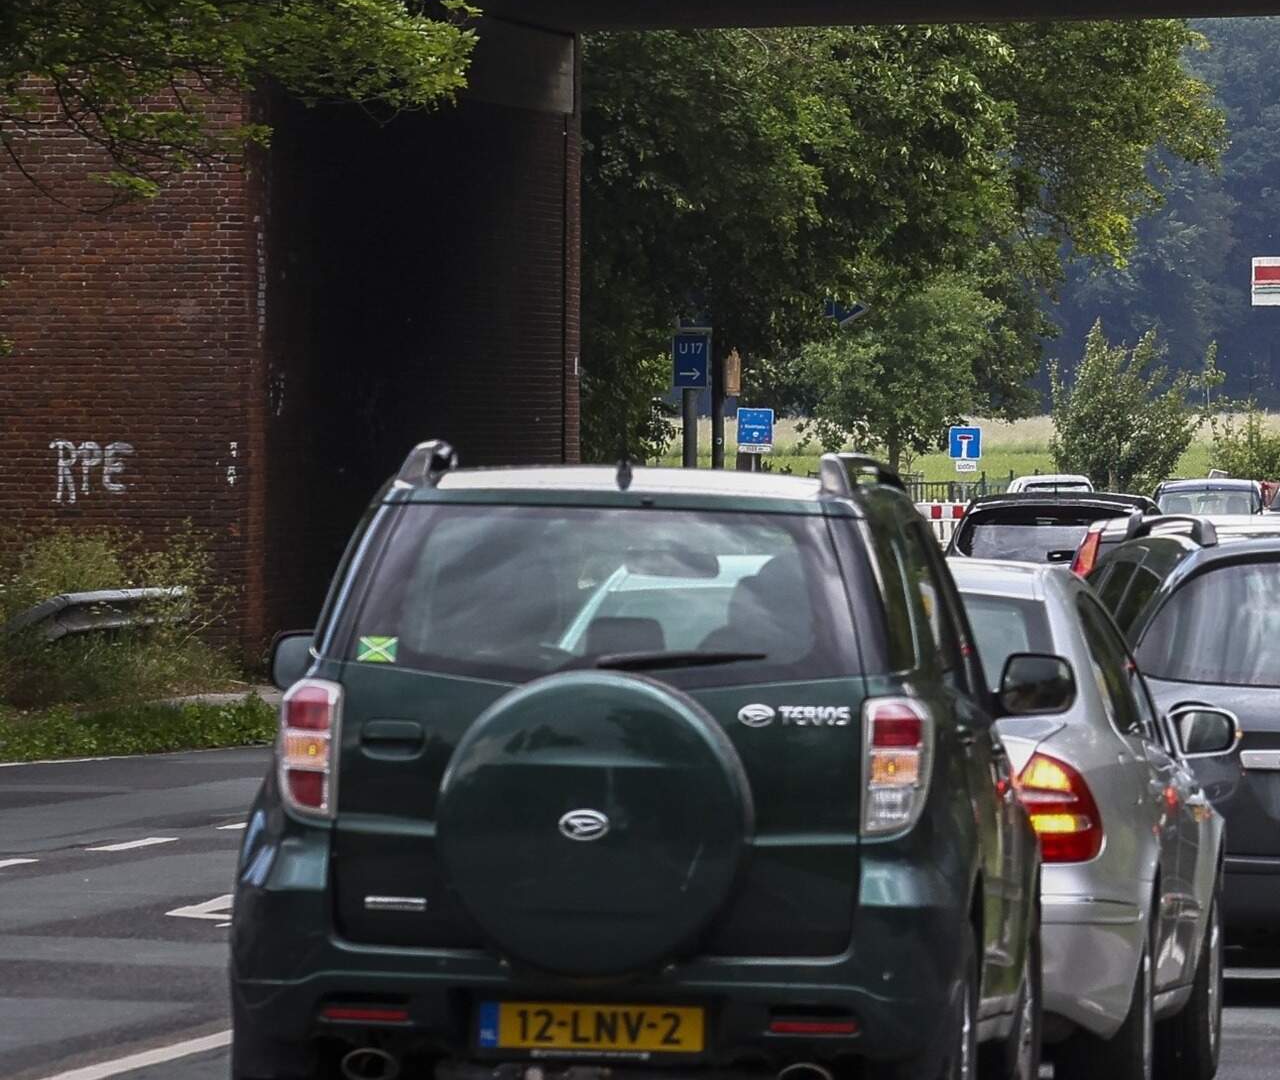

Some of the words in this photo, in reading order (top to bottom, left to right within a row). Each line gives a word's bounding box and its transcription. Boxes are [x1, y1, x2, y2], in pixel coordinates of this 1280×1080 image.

[679, 342, 688, 354] U
[691, 342, 703, 354] 17
[778, 705, 851, 726] TERIOS
[517, 1009, 682, 1046] 12-LNV-2
